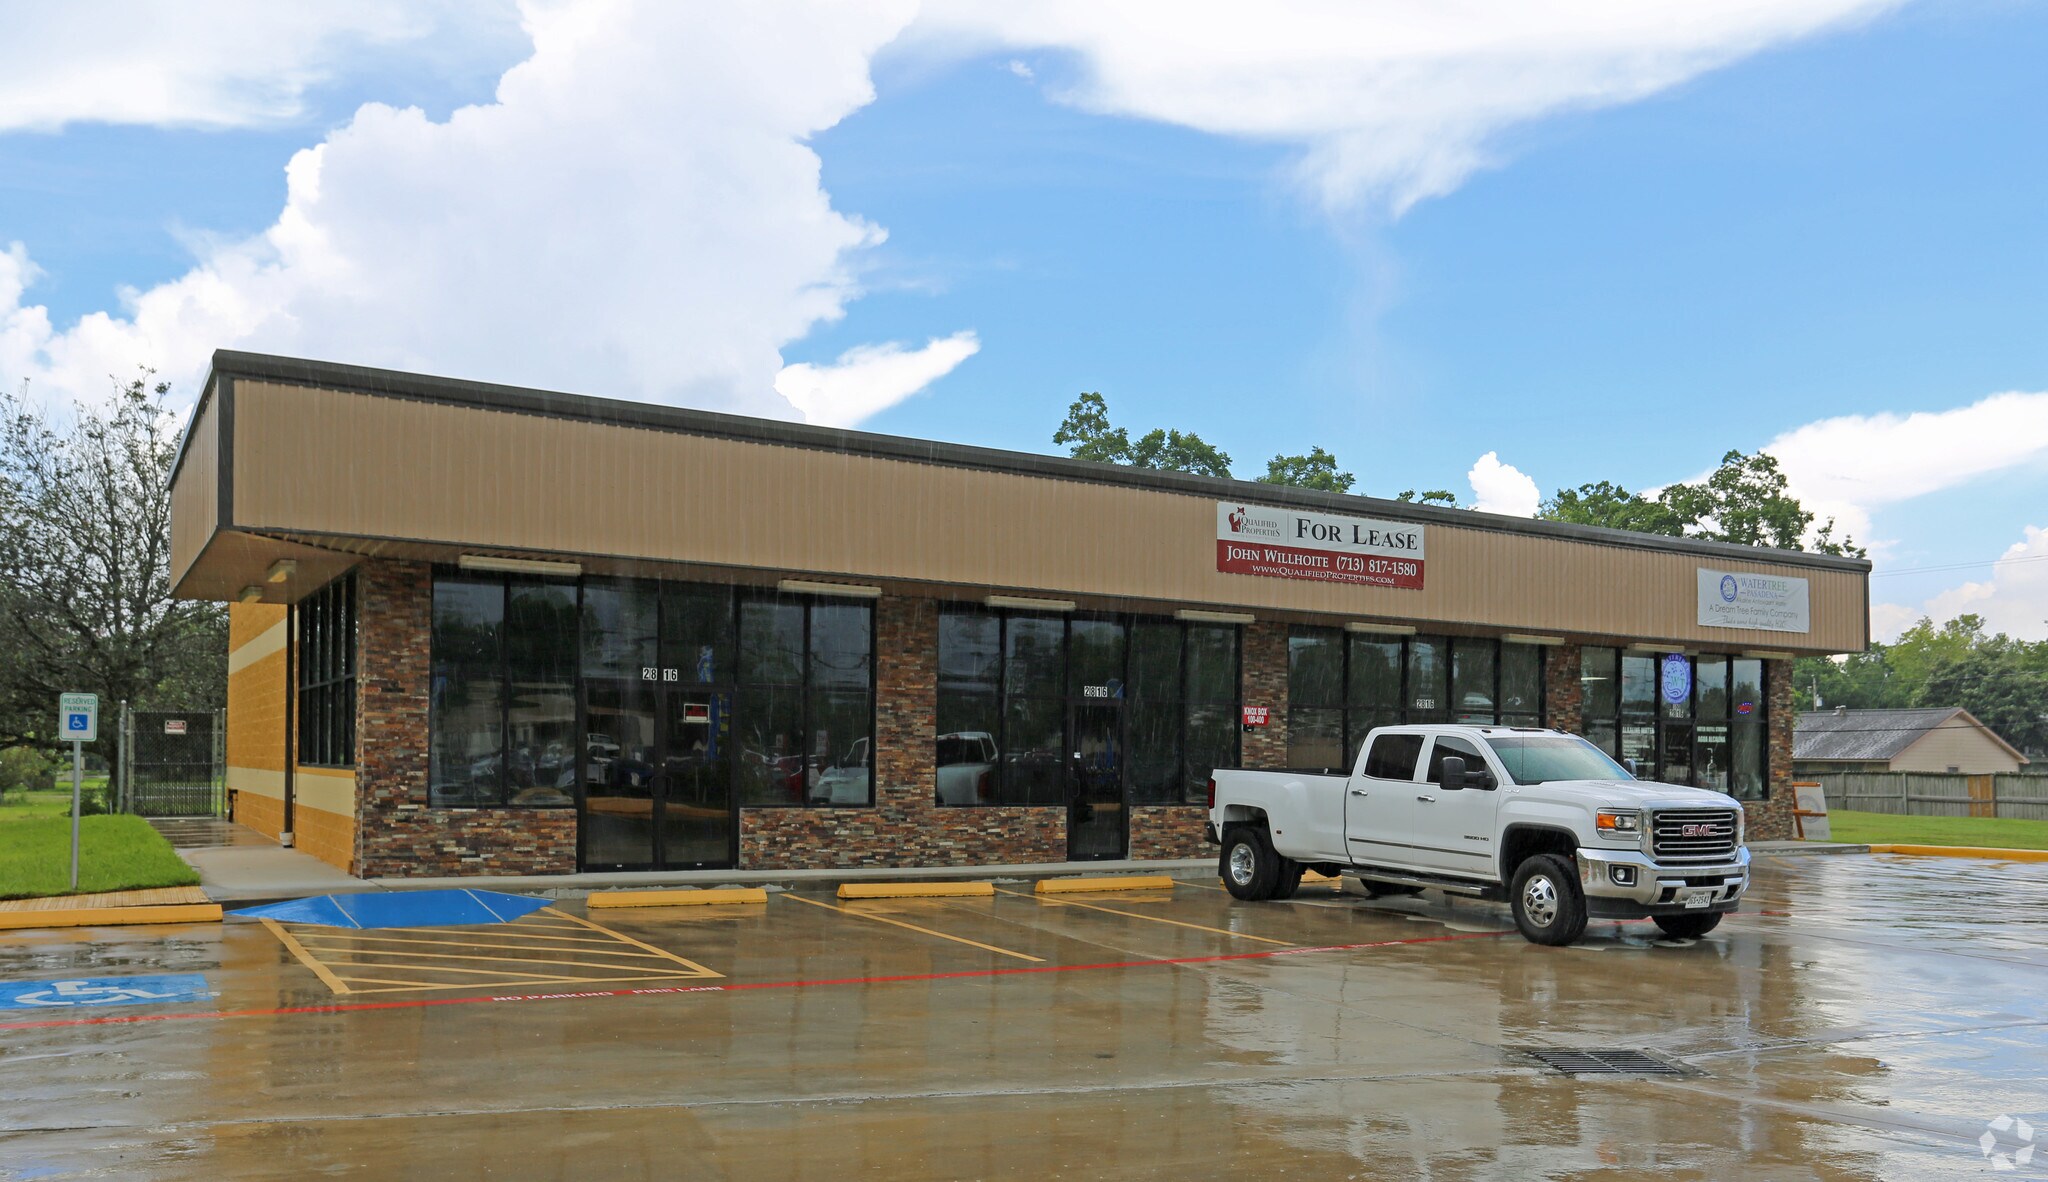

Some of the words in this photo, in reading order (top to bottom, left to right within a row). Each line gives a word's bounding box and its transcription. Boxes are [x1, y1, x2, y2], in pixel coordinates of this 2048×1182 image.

[1241, 517, 1278, 528] QUALIFIED
[1241, 525, 1281, 538] PROPERTIES
[1296, 518, 1342, 542] FOR
[1353, 525, 1418, 550] LEASE
[1227, 545, 1260, 562] JOHN
[1264, 549, 1329, 568] WILLHOITE
[1336, 555, 1364, 572] (713)
[1369, 559, 1417, 577] 817-1580
[1740, 577, 1788, 592] WATERTREE
[1746, 590, 1779, 599] PASADENA
[1709, 604, 1714, 612] A
[1715, 603, 1736, 613] Dream
[1737, 605, 1749, 615] Tree
[1750, 606, 1769, 617] Family
[1770, 608, 1798, 619] Company
[644, 669, 657, 679] 28
[664, 670, 677, 680] 16
[1084, 686, 1107, 697] 2816
[1417, 699, 1434, 709] 2816
[1257, 707, 1267, 716] BOX
[1682, 824, 1717, 837] GMC
[526, 991, 614, 1001] PARKING
